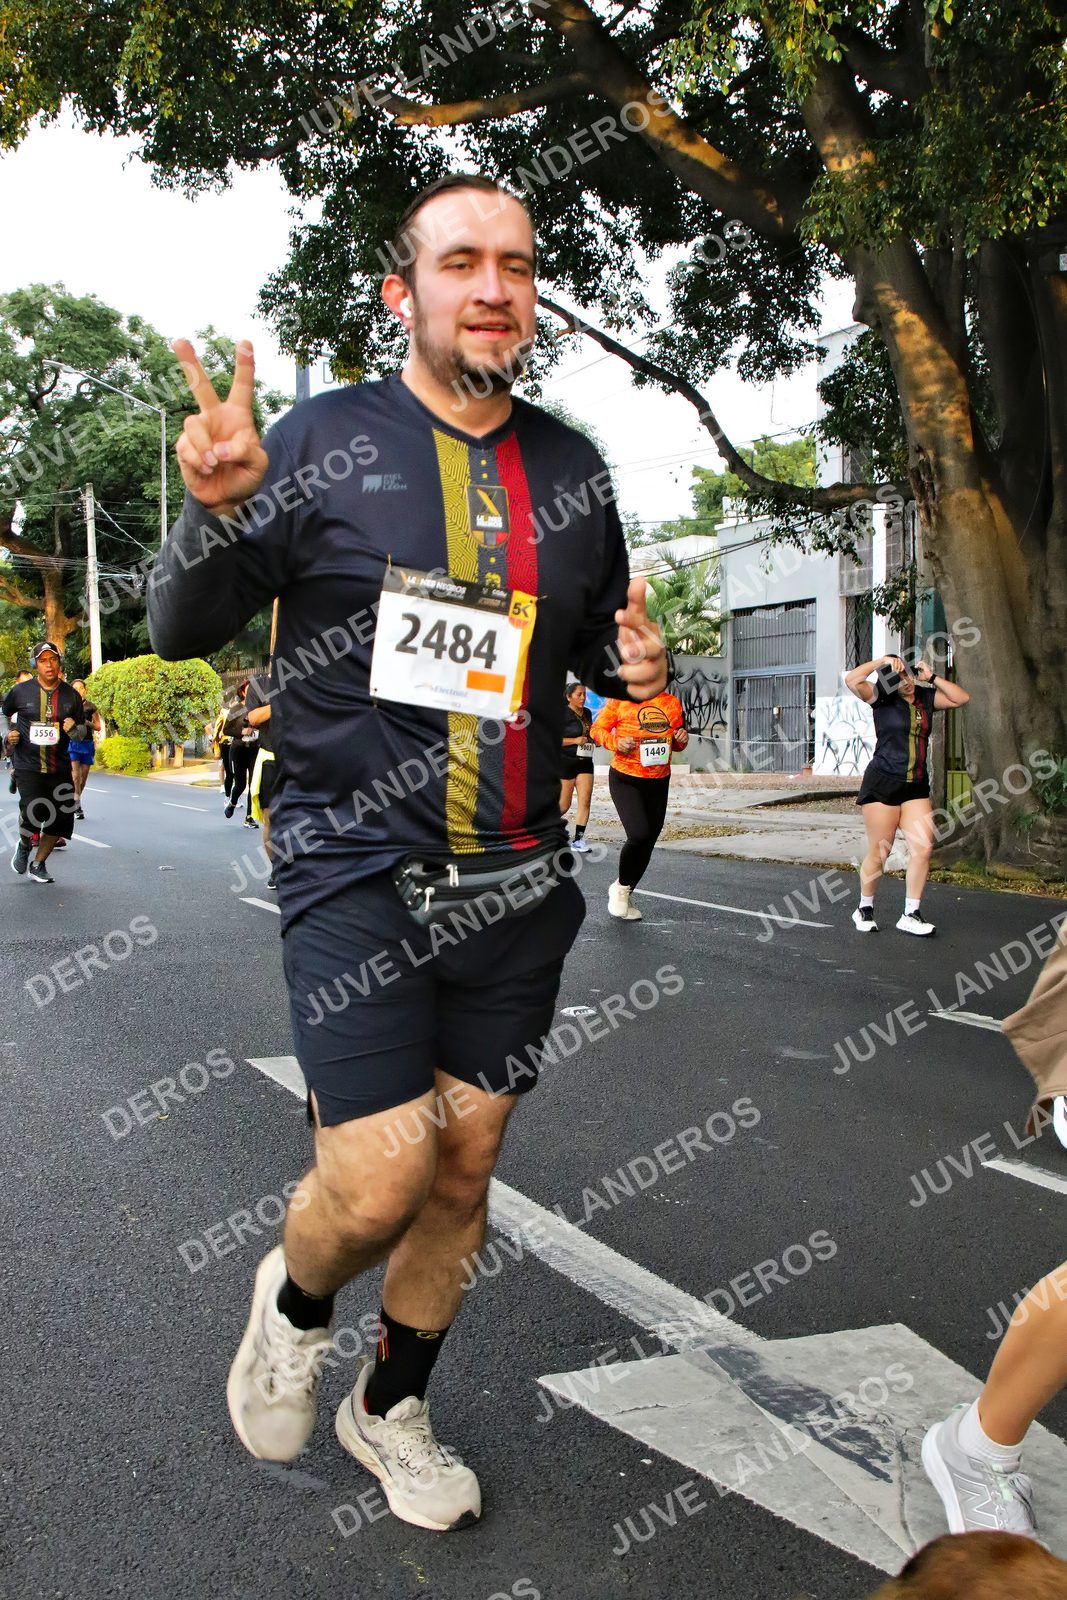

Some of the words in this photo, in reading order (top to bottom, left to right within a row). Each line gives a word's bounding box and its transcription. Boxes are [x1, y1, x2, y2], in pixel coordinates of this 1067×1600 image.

[511, 602, 530, 618] 5K
[395, 612, 497, 670] 2484
[34, 729, 54, 738] 3556
[644, 746, 666, 757] 1449
